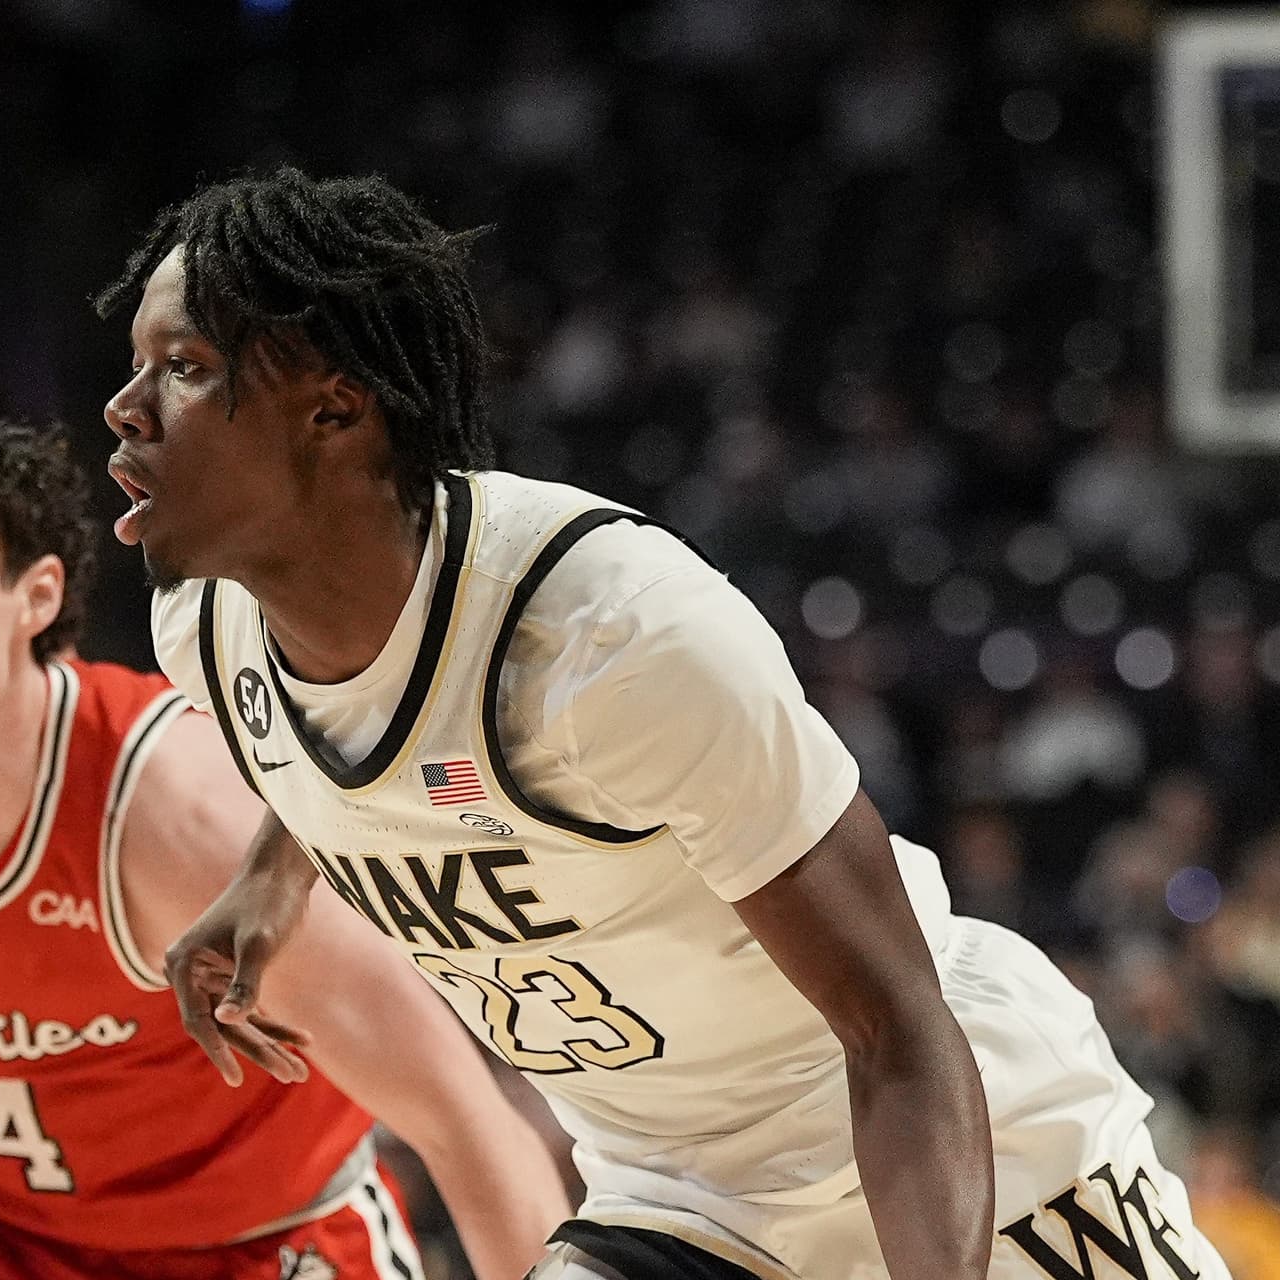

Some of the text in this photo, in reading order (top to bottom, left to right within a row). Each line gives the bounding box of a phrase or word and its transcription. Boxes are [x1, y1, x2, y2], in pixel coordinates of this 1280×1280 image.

[238, 675, 268, 731] 54
[28, 889, 99, 933] CAA
[311, 846, 583, 950] WAKE
[412, 953, 665, 1075] 23
